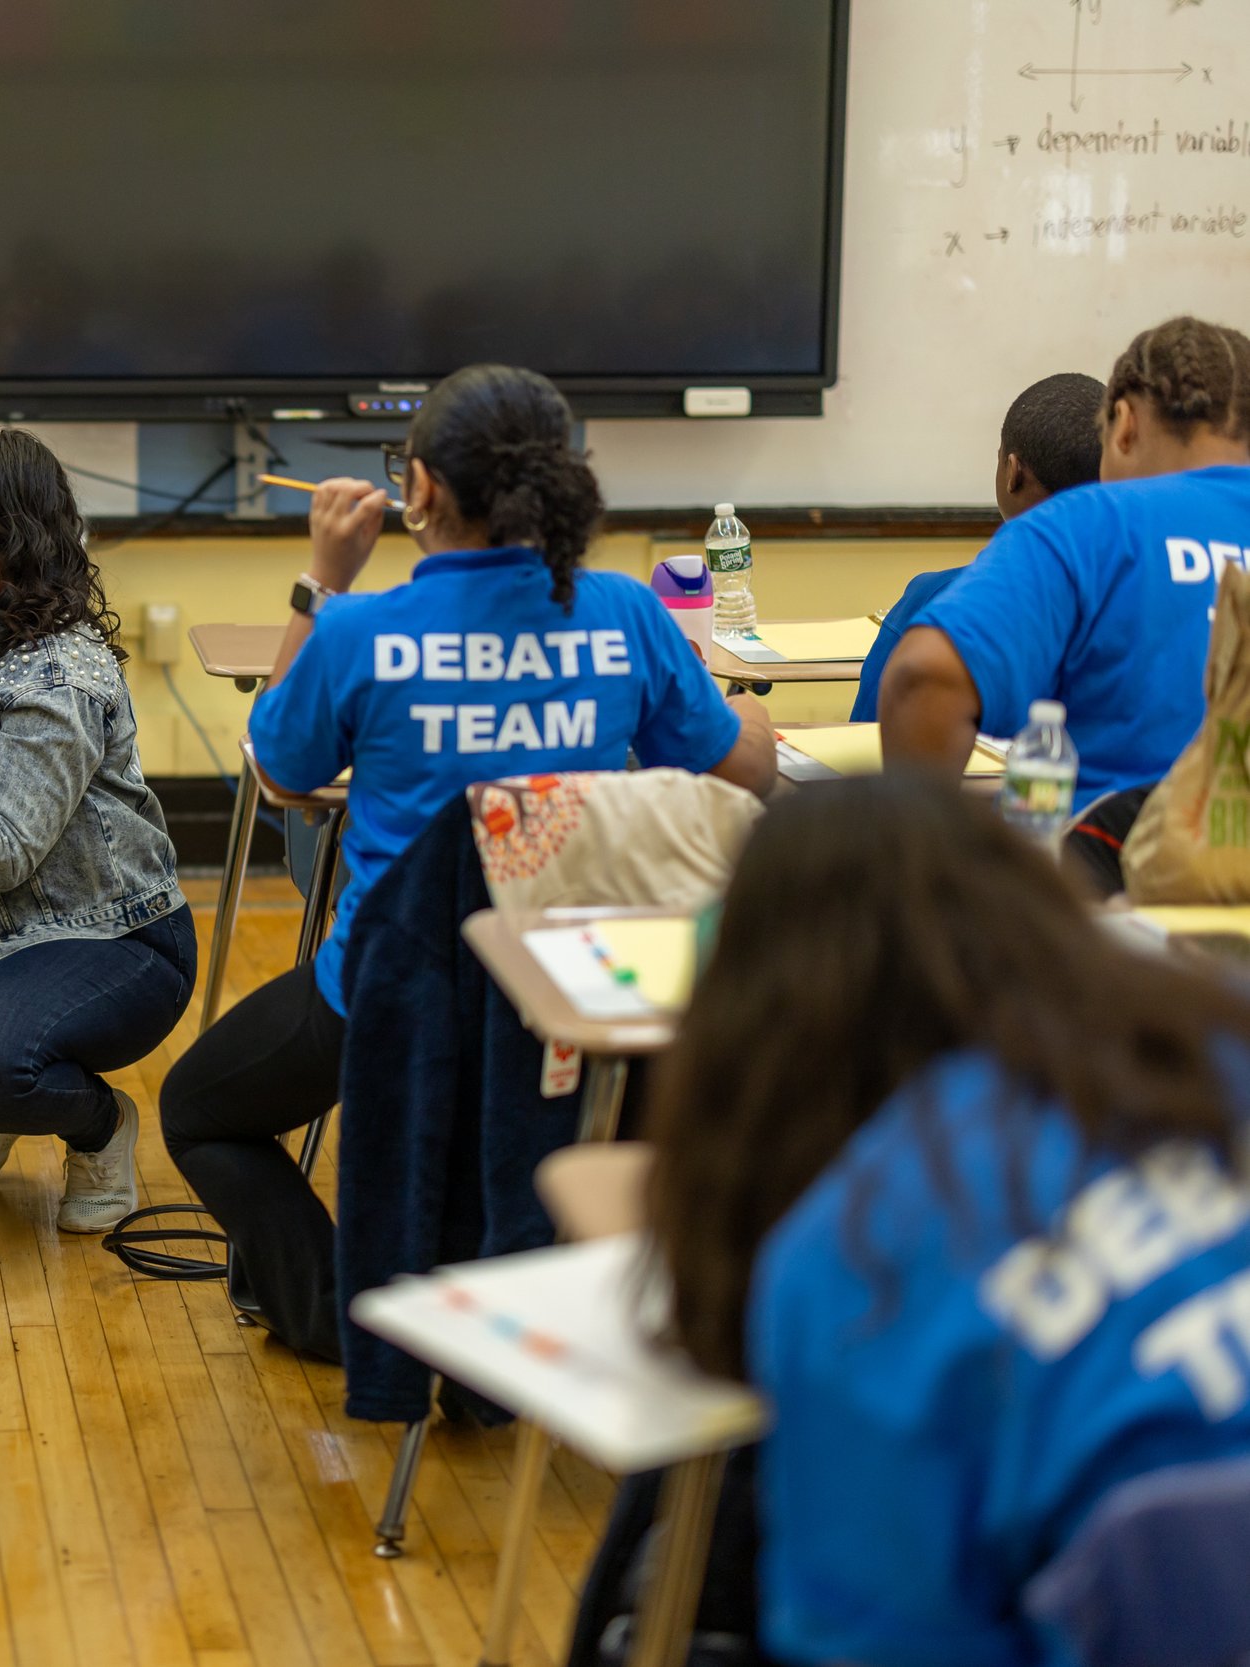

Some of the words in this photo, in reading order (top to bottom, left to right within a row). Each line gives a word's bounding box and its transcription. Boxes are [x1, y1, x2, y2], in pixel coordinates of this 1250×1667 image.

[1036, 112, 1165, 170] dependent
[1175, 118, 1250, 158] variabl
[1165, 536, 1250, 585] DE
[373, 629, 632, 682] DEBATE
[409, 699, 598, 753] TEAM
